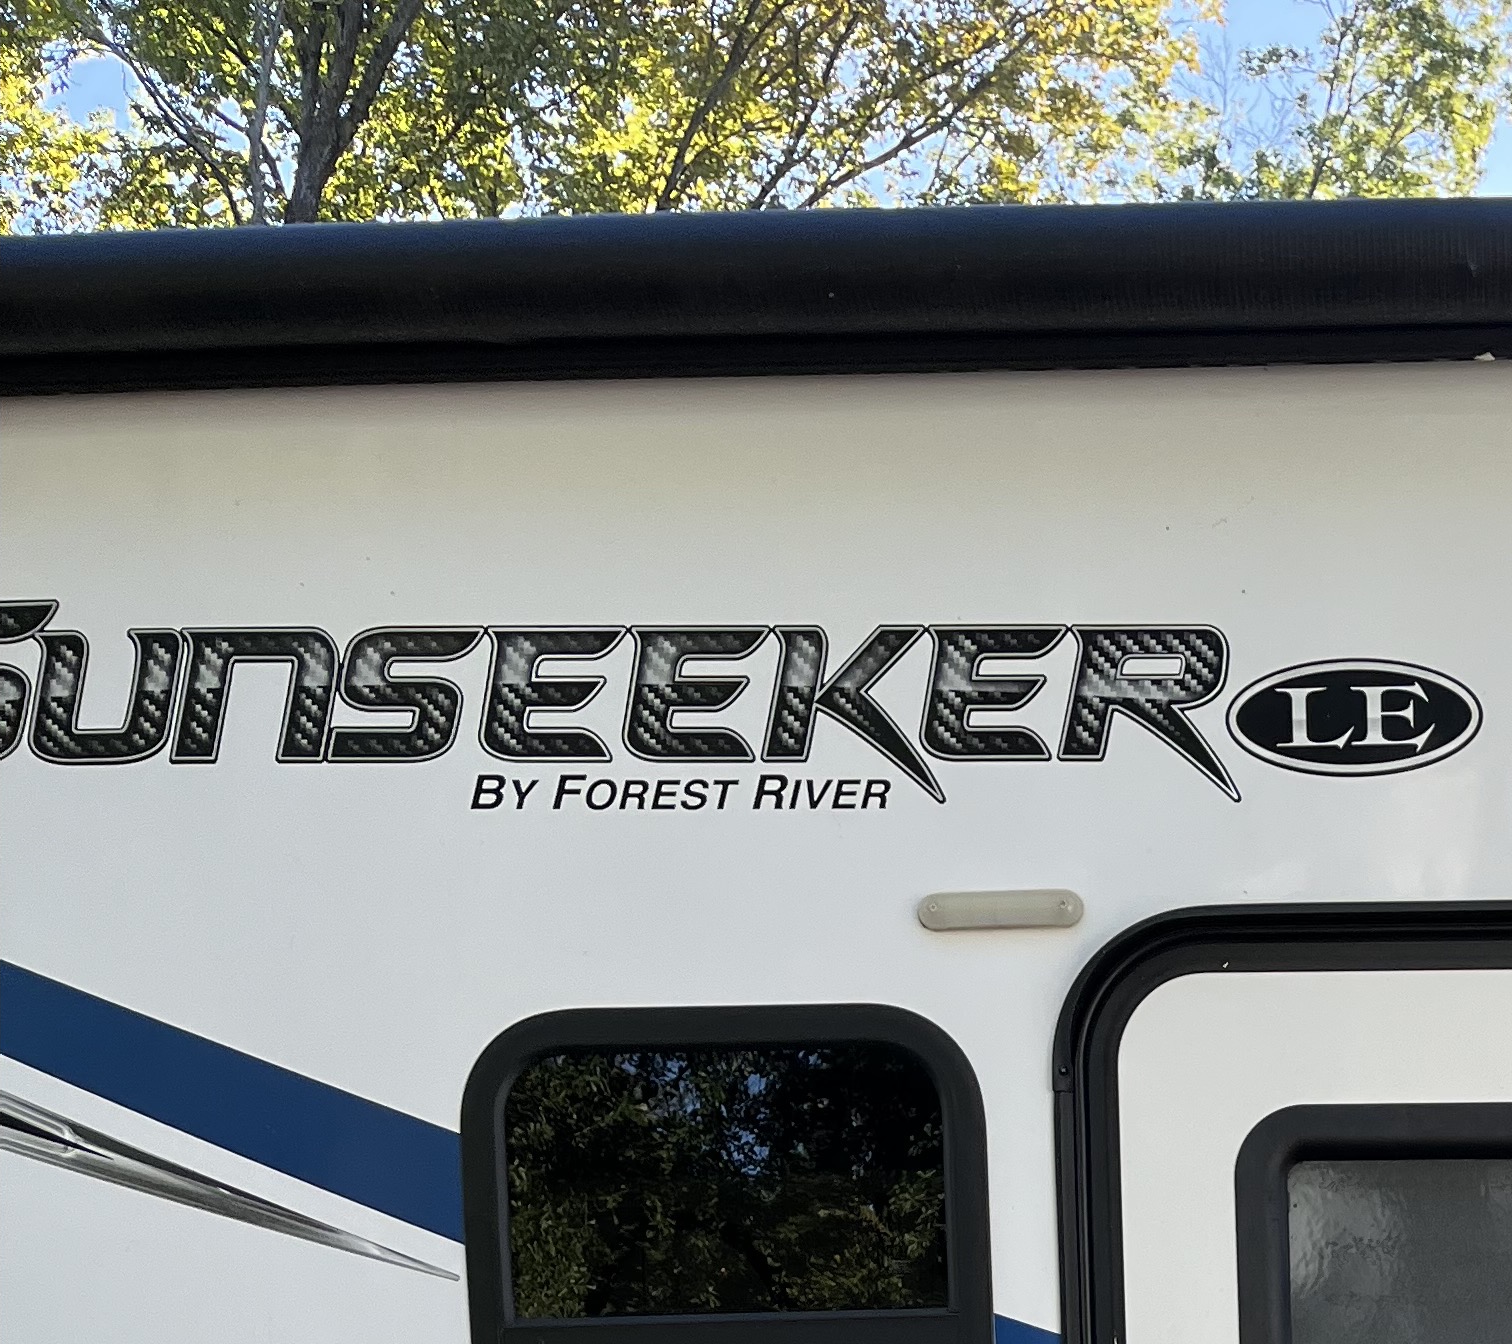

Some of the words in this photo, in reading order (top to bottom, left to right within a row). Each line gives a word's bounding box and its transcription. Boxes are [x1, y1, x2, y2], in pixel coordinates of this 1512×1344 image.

[1274, 681, 1436, 753] LE
[470, 773, 539, 810] BY
[552, 773, 740, 811] FOREST
[752, 773, 892, 811] RIVER
